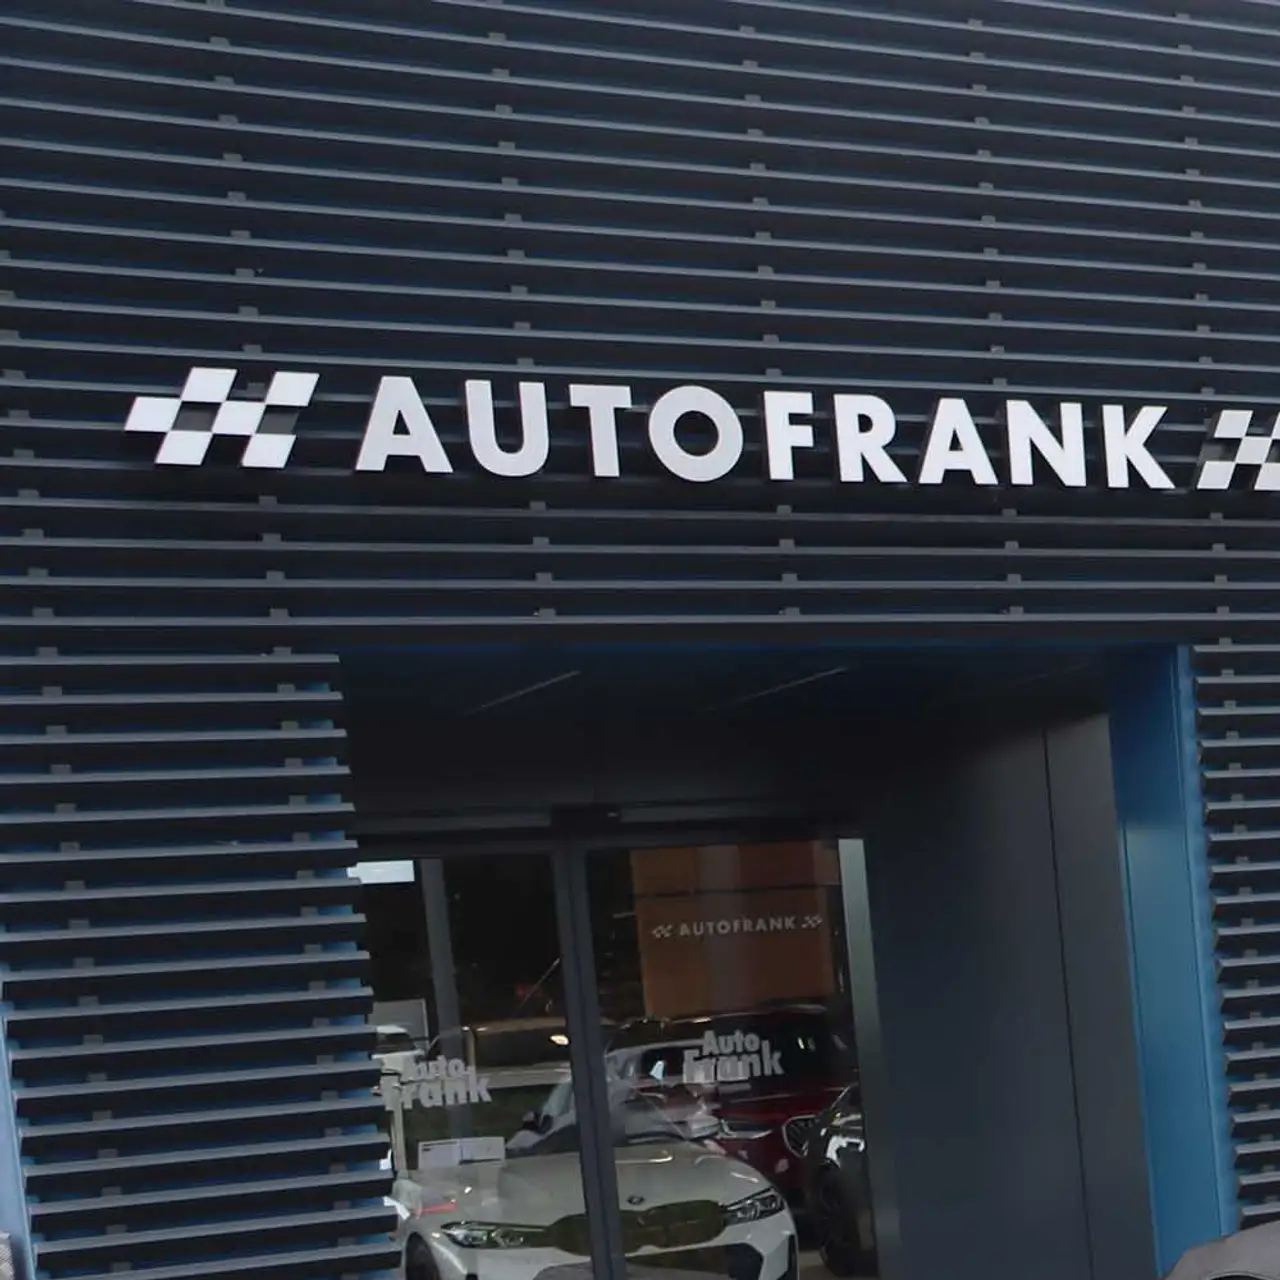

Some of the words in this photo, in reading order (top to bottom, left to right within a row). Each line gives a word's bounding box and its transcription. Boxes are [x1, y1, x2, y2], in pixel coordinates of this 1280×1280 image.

[355, 375, 1176, 490] AUTOFRANK
[679, 915, 796, 937] AUTOFRANK
[702, 1029, 760, 1056] Auto
[683, 1040, 785, 1084] Frank
